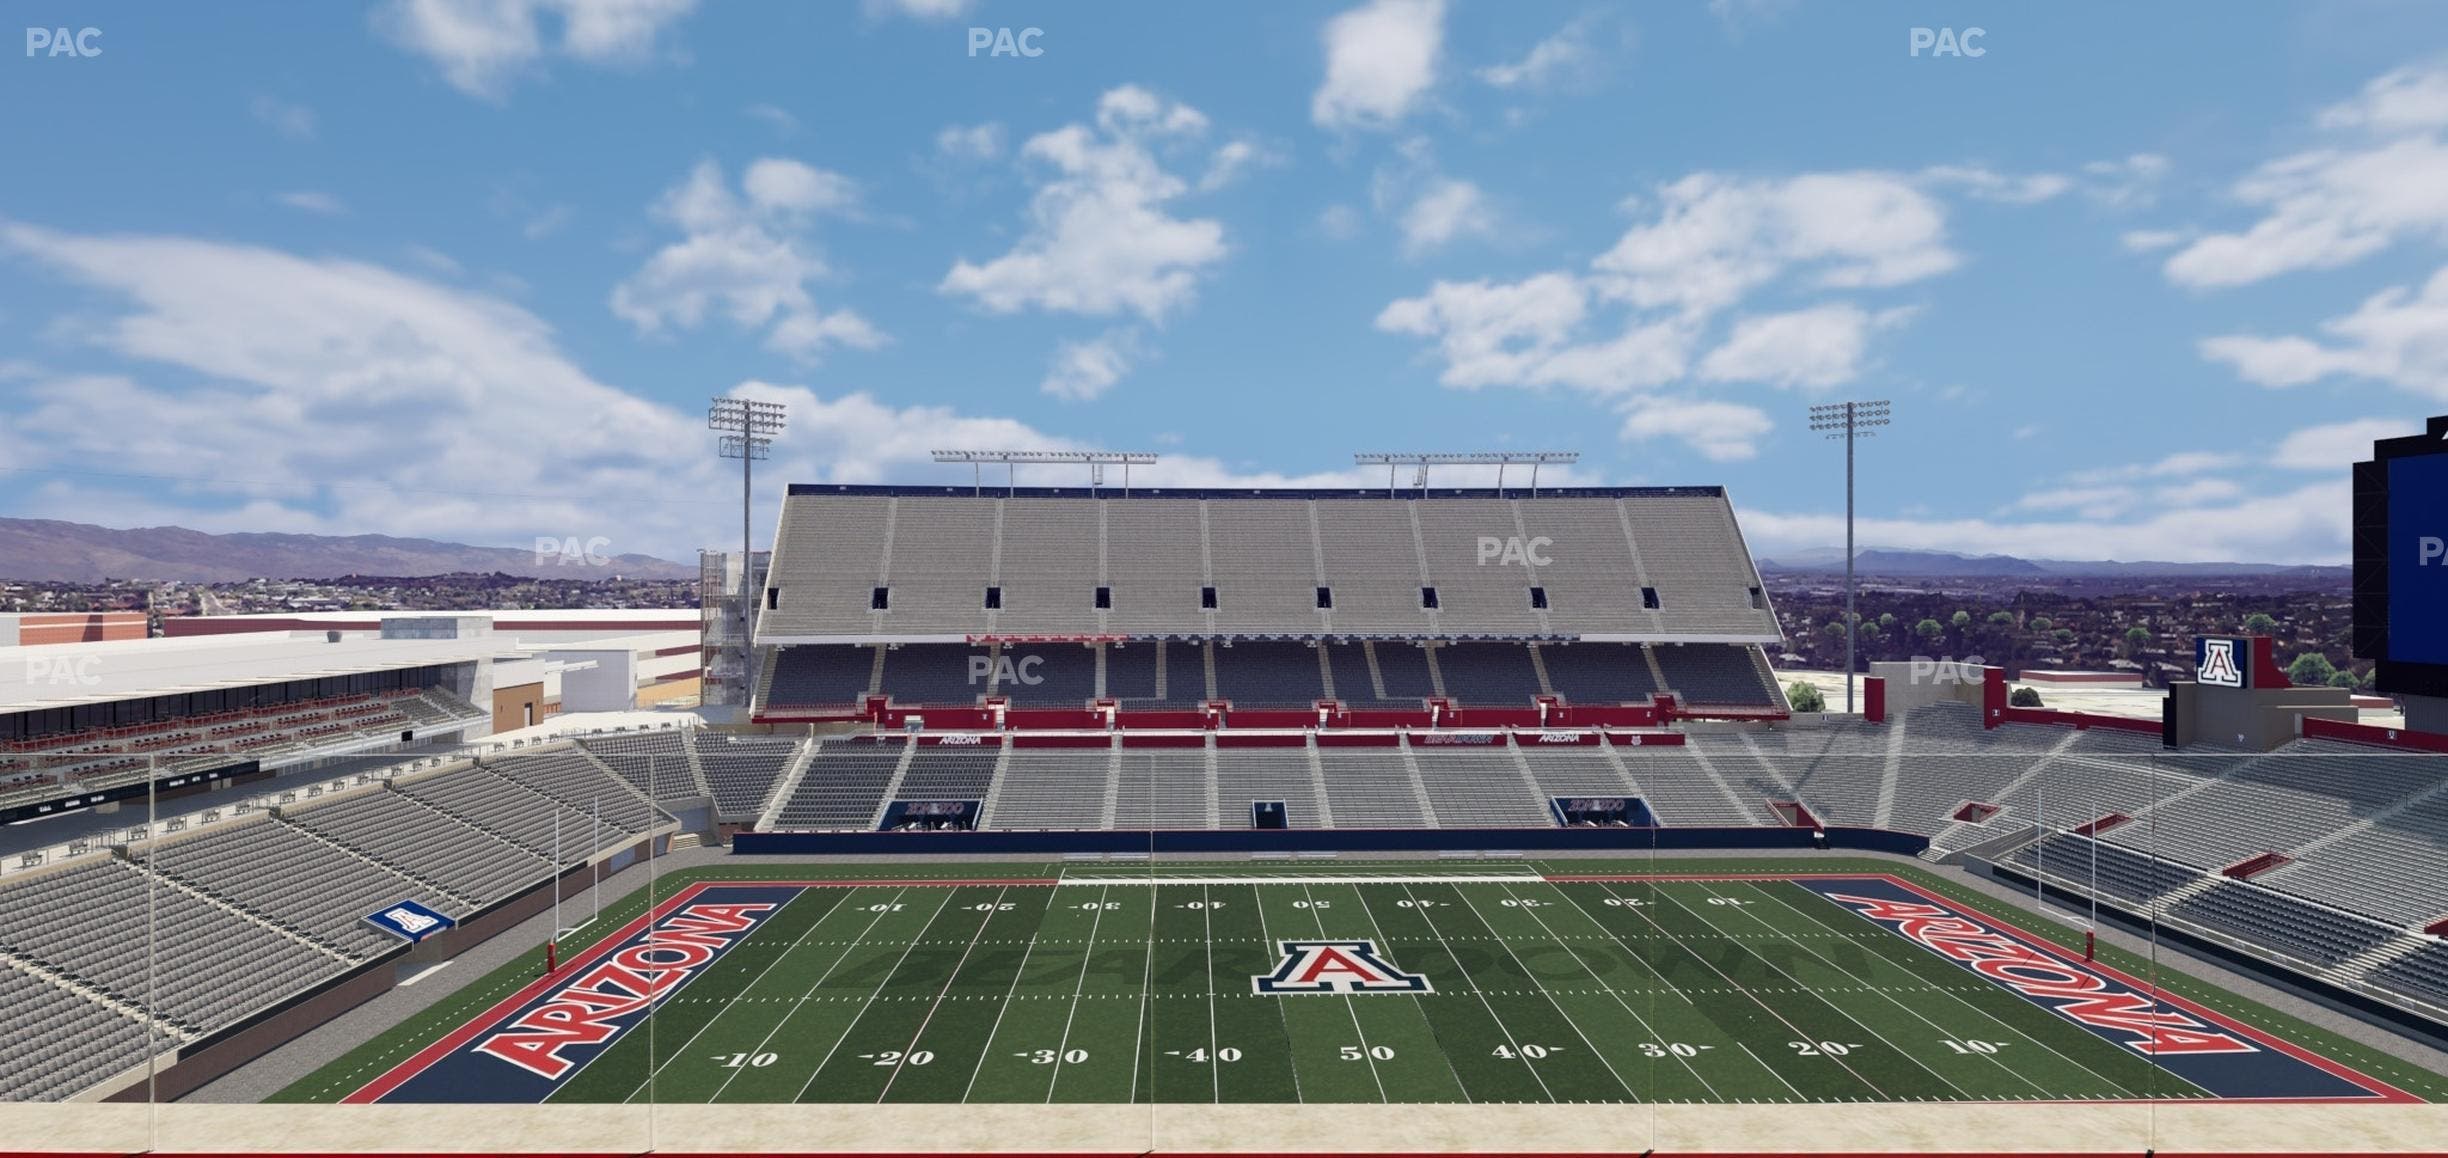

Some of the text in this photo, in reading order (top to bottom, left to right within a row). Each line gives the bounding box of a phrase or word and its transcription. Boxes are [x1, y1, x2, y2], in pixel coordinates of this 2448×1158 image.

[940, 735, 981, 744] ARIZONA
[1538, 734, 1580, 743] ARIZONA
[1252, 940, 1434, 995] A
[1824, 893, 2261, 1054] ARIZONA
[475, 903, 776, 1080] ARIZONA
[1341, 1046, 1395, 1060] 50
[1492, 1044, 1547, 1059] 40
[1638, 1042, 1698, 1058] 30
[1789, 1042, 1849, 1055] 20
[1938, 1039, 1998, 1054] 10
[721, 1053, 778, 1067] 10
[874, 1051, 933, 1065] 20
[1031, 1050, 1087, 1064] 30
[1186, 1048, 1241, 1062] 40
